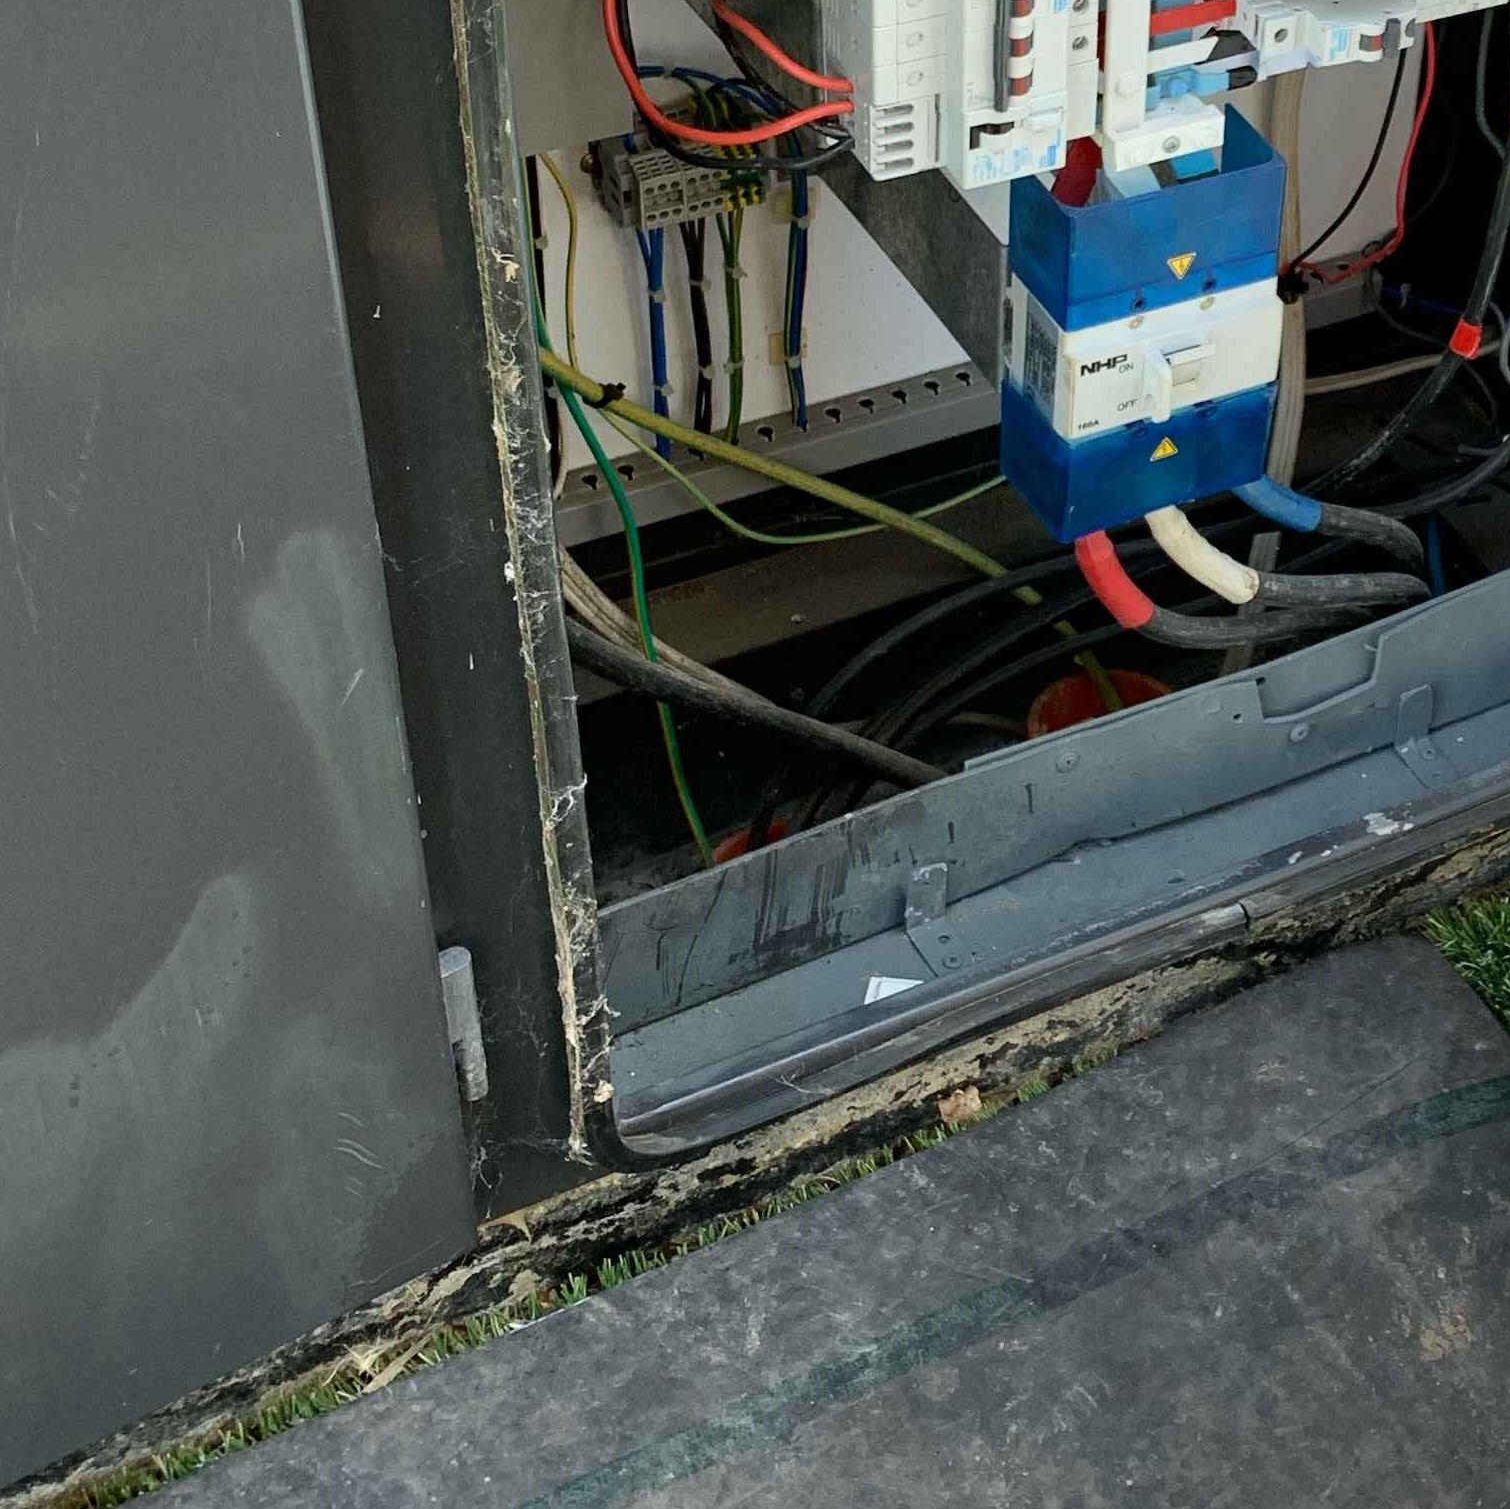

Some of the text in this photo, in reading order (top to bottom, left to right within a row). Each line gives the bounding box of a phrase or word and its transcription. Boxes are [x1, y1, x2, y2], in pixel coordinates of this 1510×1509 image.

[1080, 354, 1127, 376] NHP
[1118, 362, 1133, 374] ON
[1117, 398, 1138, 412] OFF
